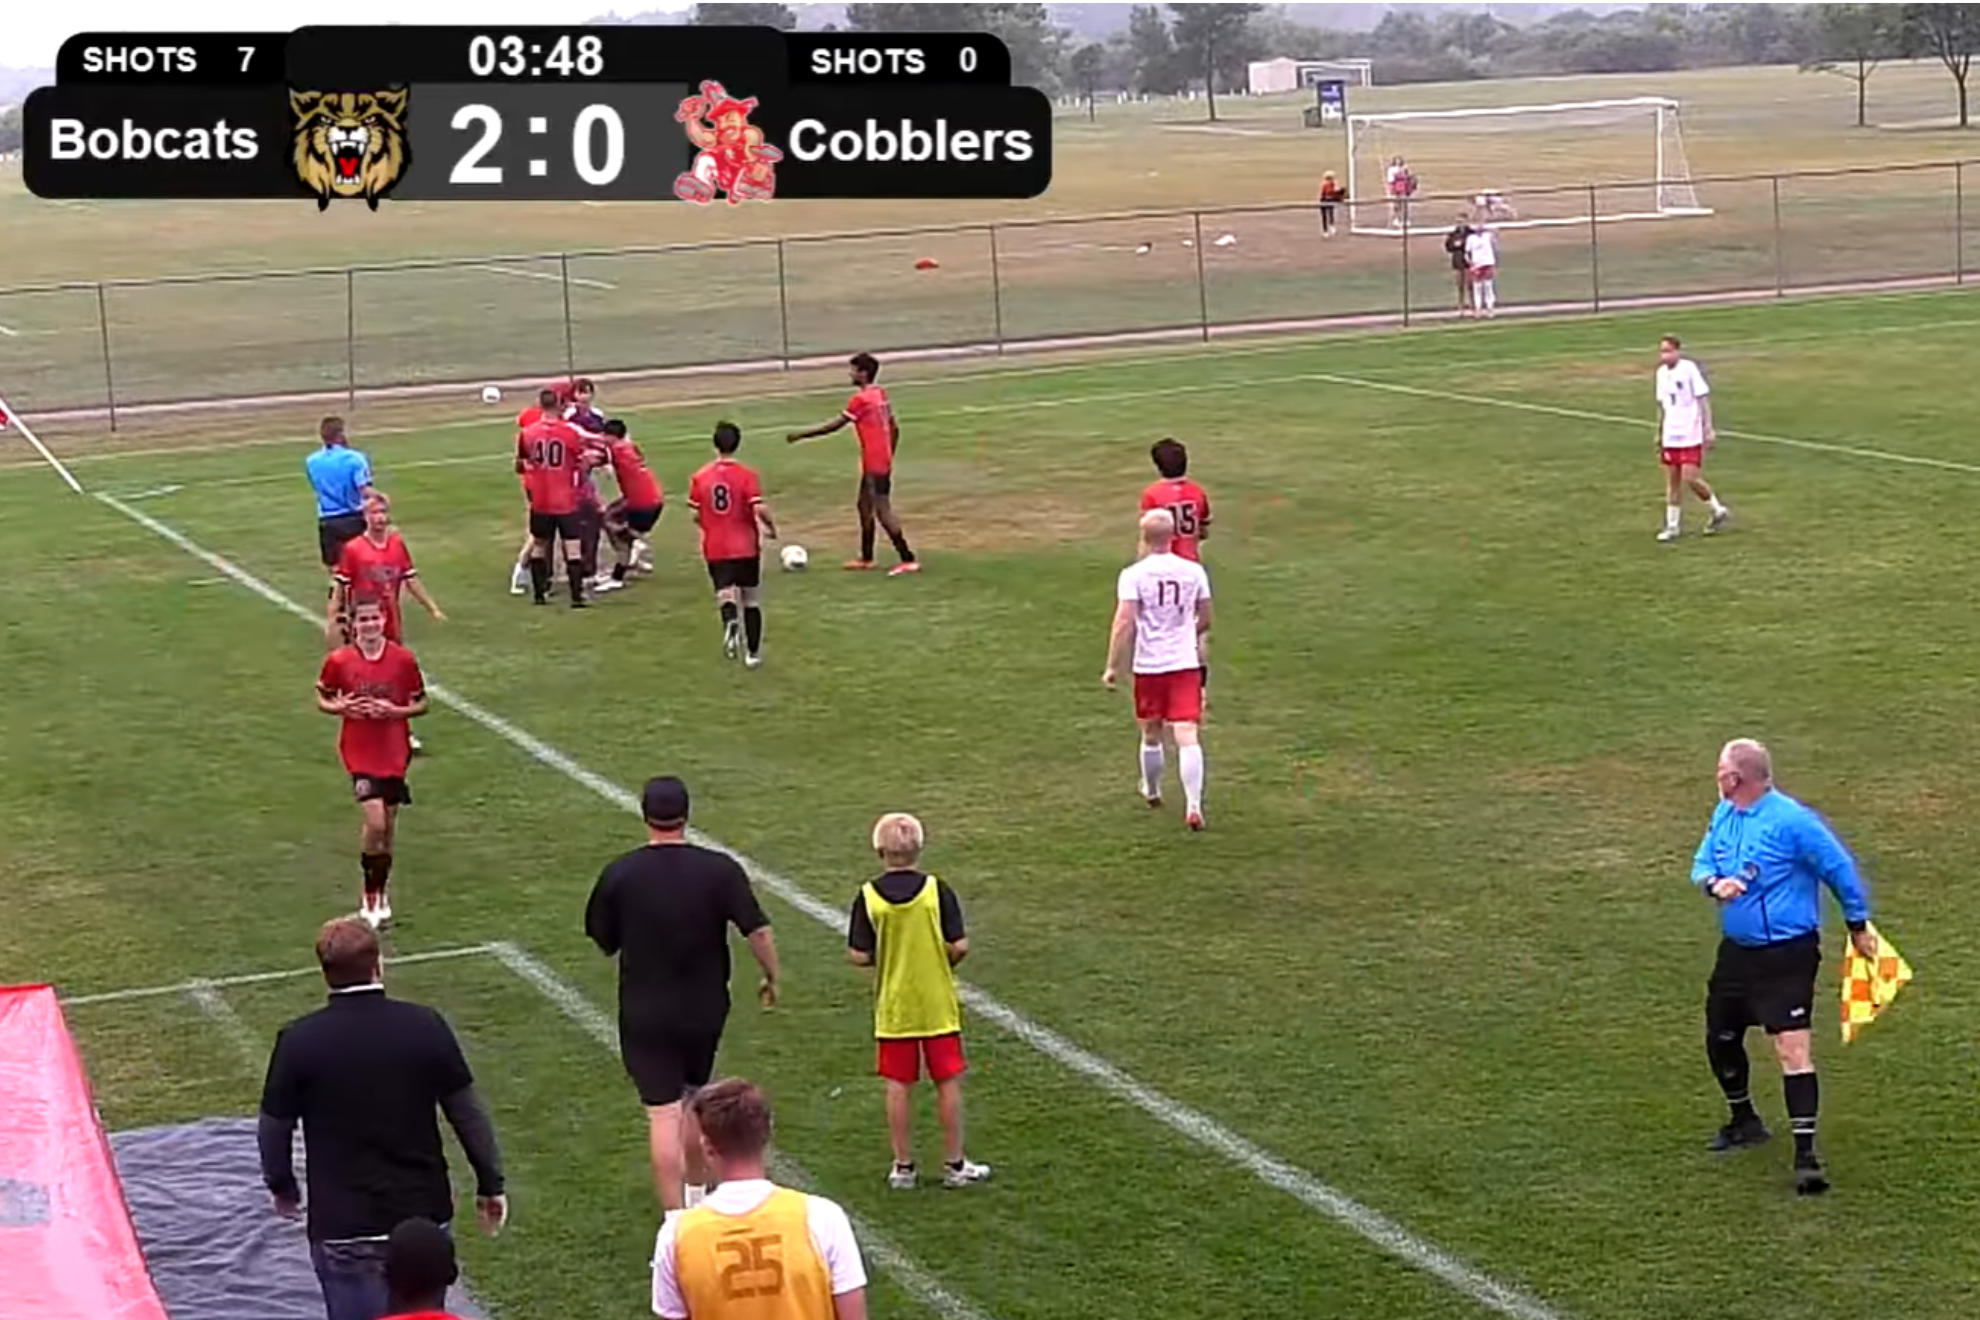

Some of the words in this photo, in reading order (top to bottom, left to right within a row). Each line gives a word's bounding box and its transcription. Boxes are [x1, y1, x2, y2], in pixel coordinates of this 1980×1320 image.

[713, 484, 730, 512] 8
[1167, 502, 1197, 536] 15
[1158, 580, 1180, 606] 17
[715, 1233, 784, 1300] 25
